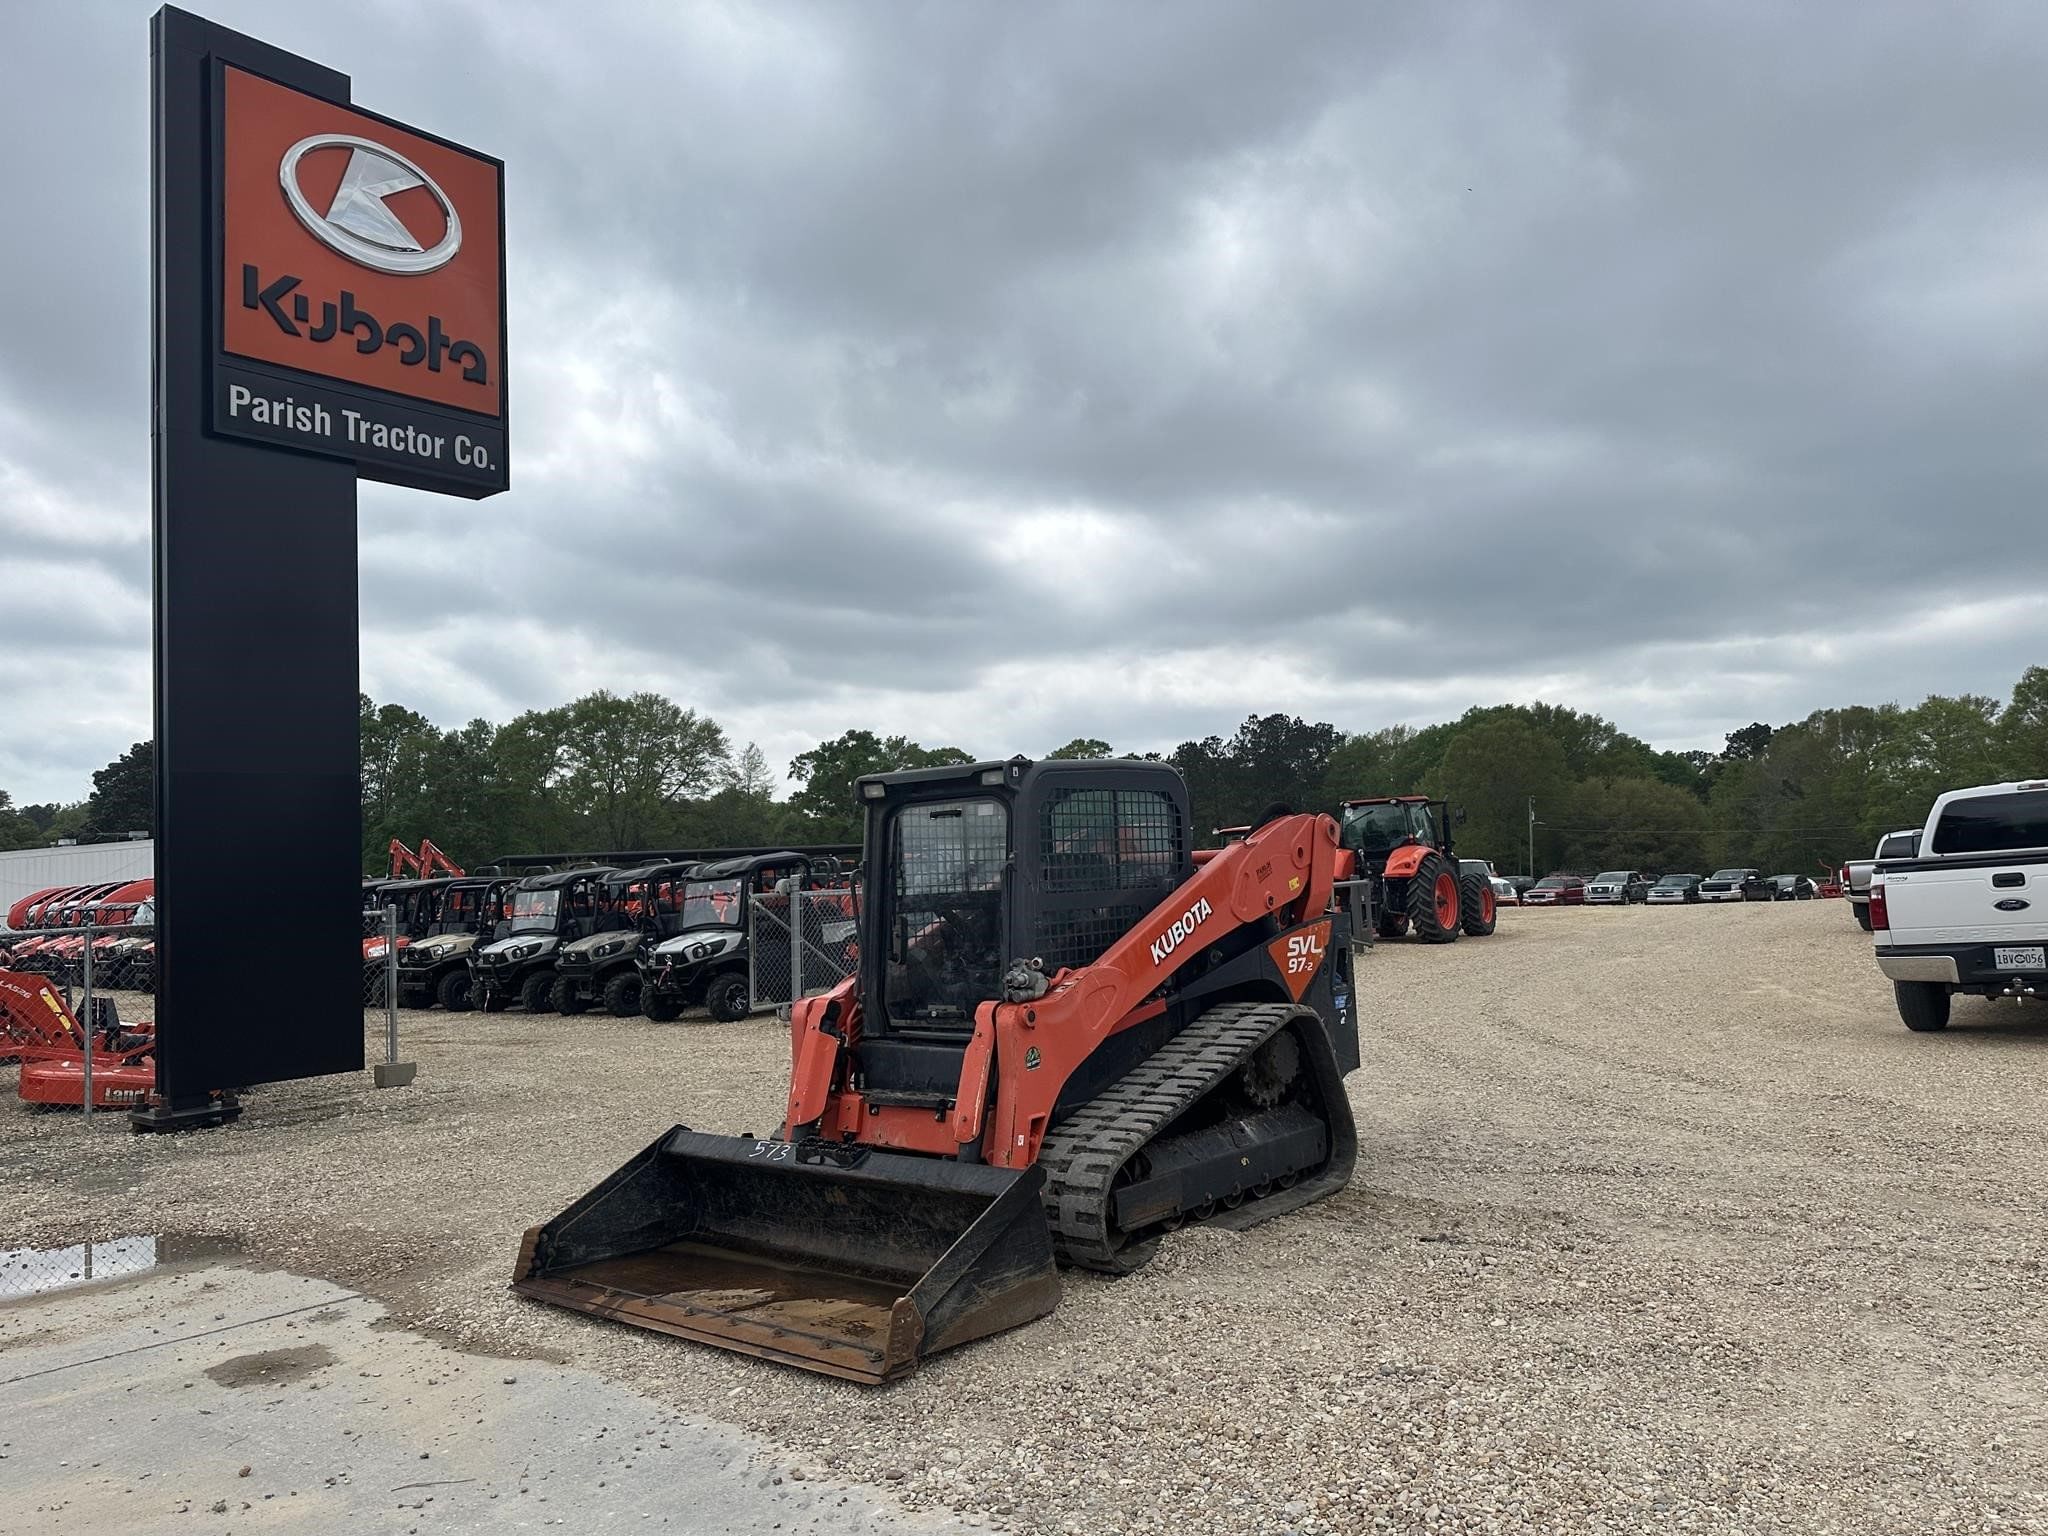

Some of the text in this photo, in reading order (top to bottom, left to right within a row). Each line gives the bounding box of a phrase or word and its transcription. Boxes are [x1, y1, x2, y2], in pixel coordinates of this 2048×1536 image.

[243, 263, 488, 386] Kubota
[229, 384, 496, 471] Parish Tractor Co.
[1149, 896, 1214, 967] KUBOTA
[1287, 935, 1323, 957] SVL
[1288, 957, 1314, 974] 97-2
[748, 1140, 791, 1161] 573
